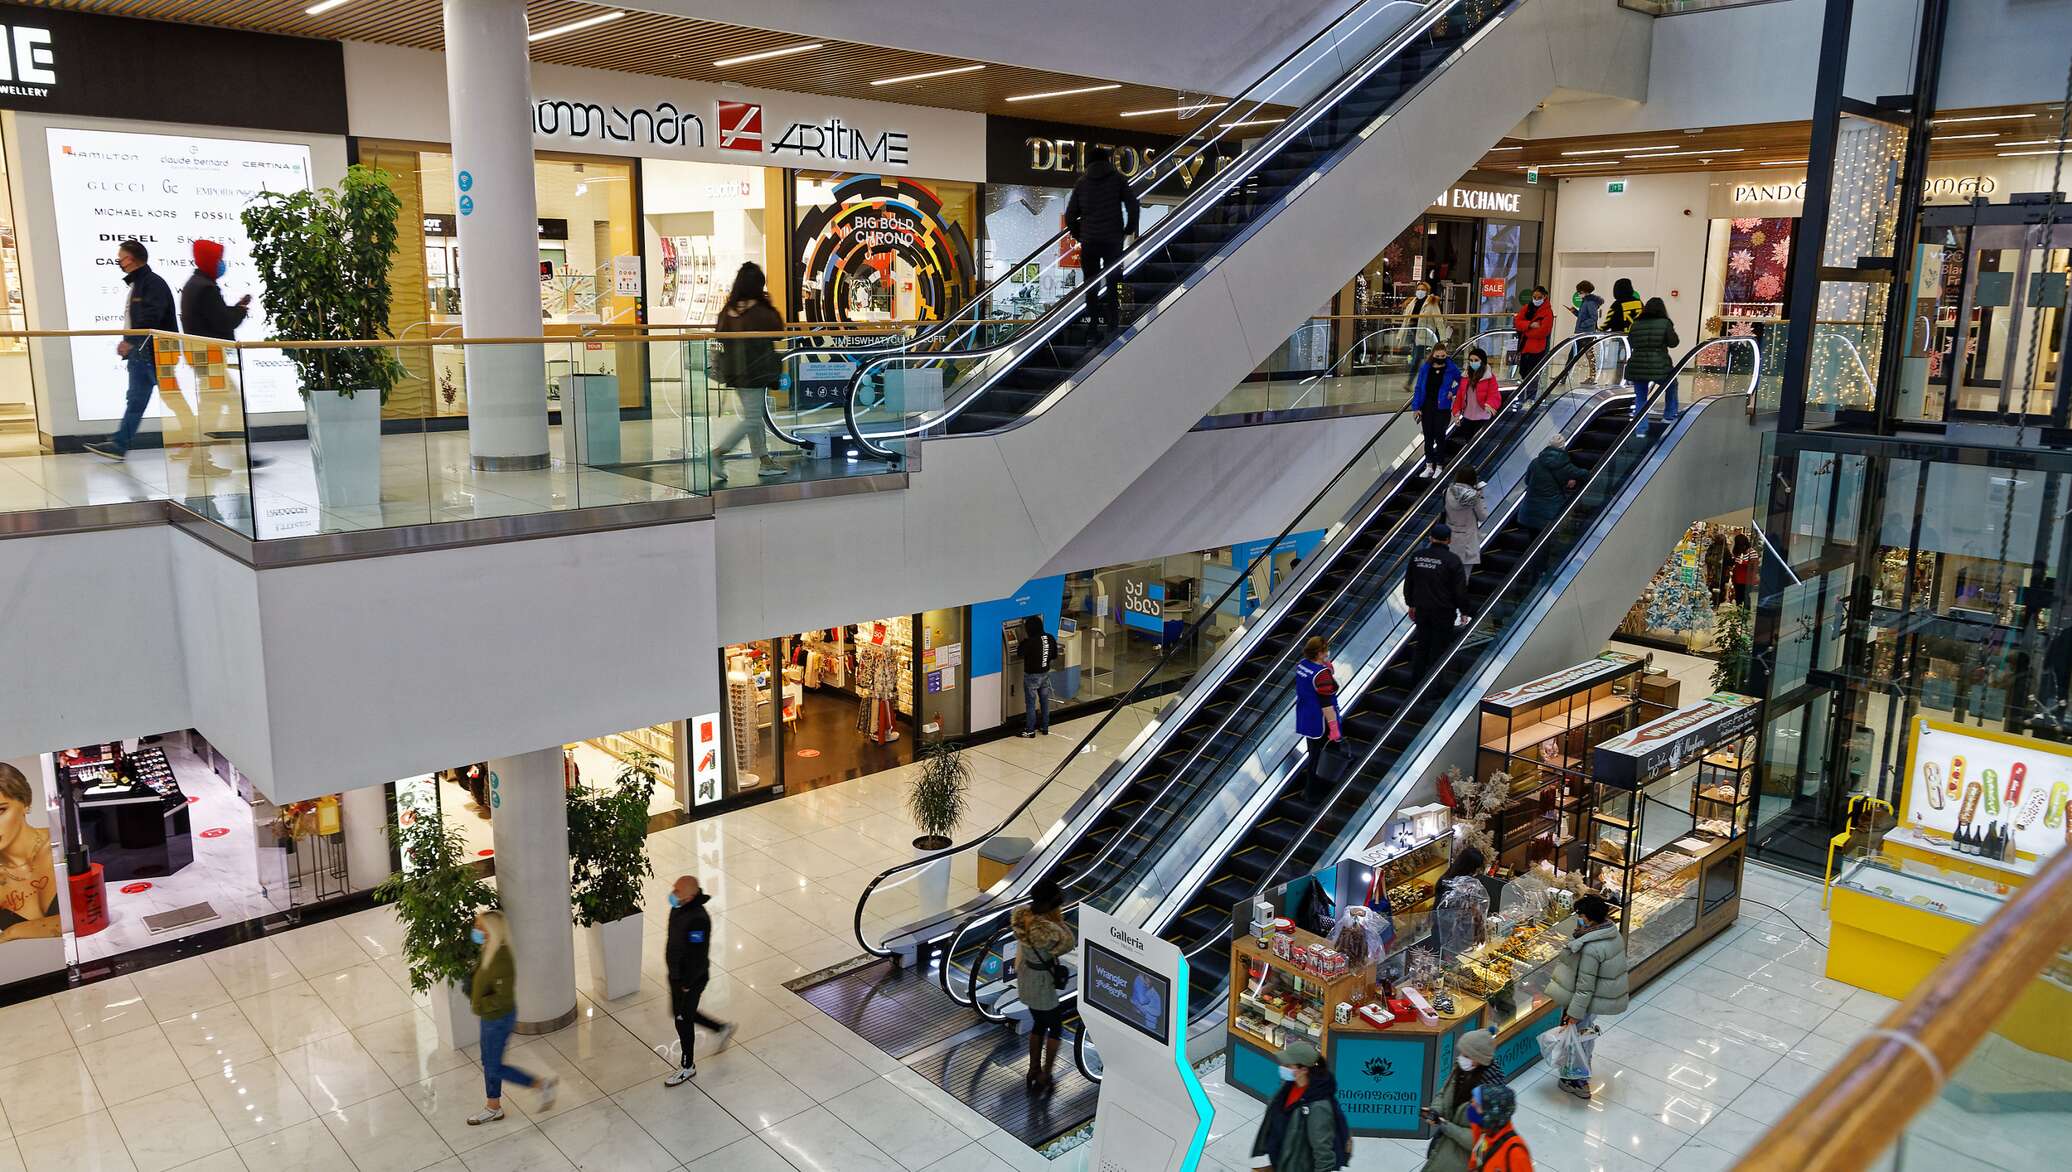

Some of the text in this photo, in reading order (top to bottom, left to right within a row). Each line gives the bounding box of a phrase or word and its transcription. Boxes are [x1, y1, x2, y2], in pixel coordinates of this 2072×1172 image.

[0, 24, 56, 85] E
[242, 161, 290, 170] CERTINA
[1453, 188, 1521, 212] EXCHANGE
[94, 207, 177, 219] MICHAEL KORS
[194, 211, 234, 221] FOSSIL
[855, 216, 914, 230] BIG BOLD
[99, 233, 158, 243] DIESEL
[855, 230, 914, 246] CHRONO
[159, 258, 195, 267] TIMEX
[1483, 284, 1503, 293] SALE
[1110, 926, 1145, 951] Galleria
[1338, 1103, 1417, 1115] CHIRIFRUIT
